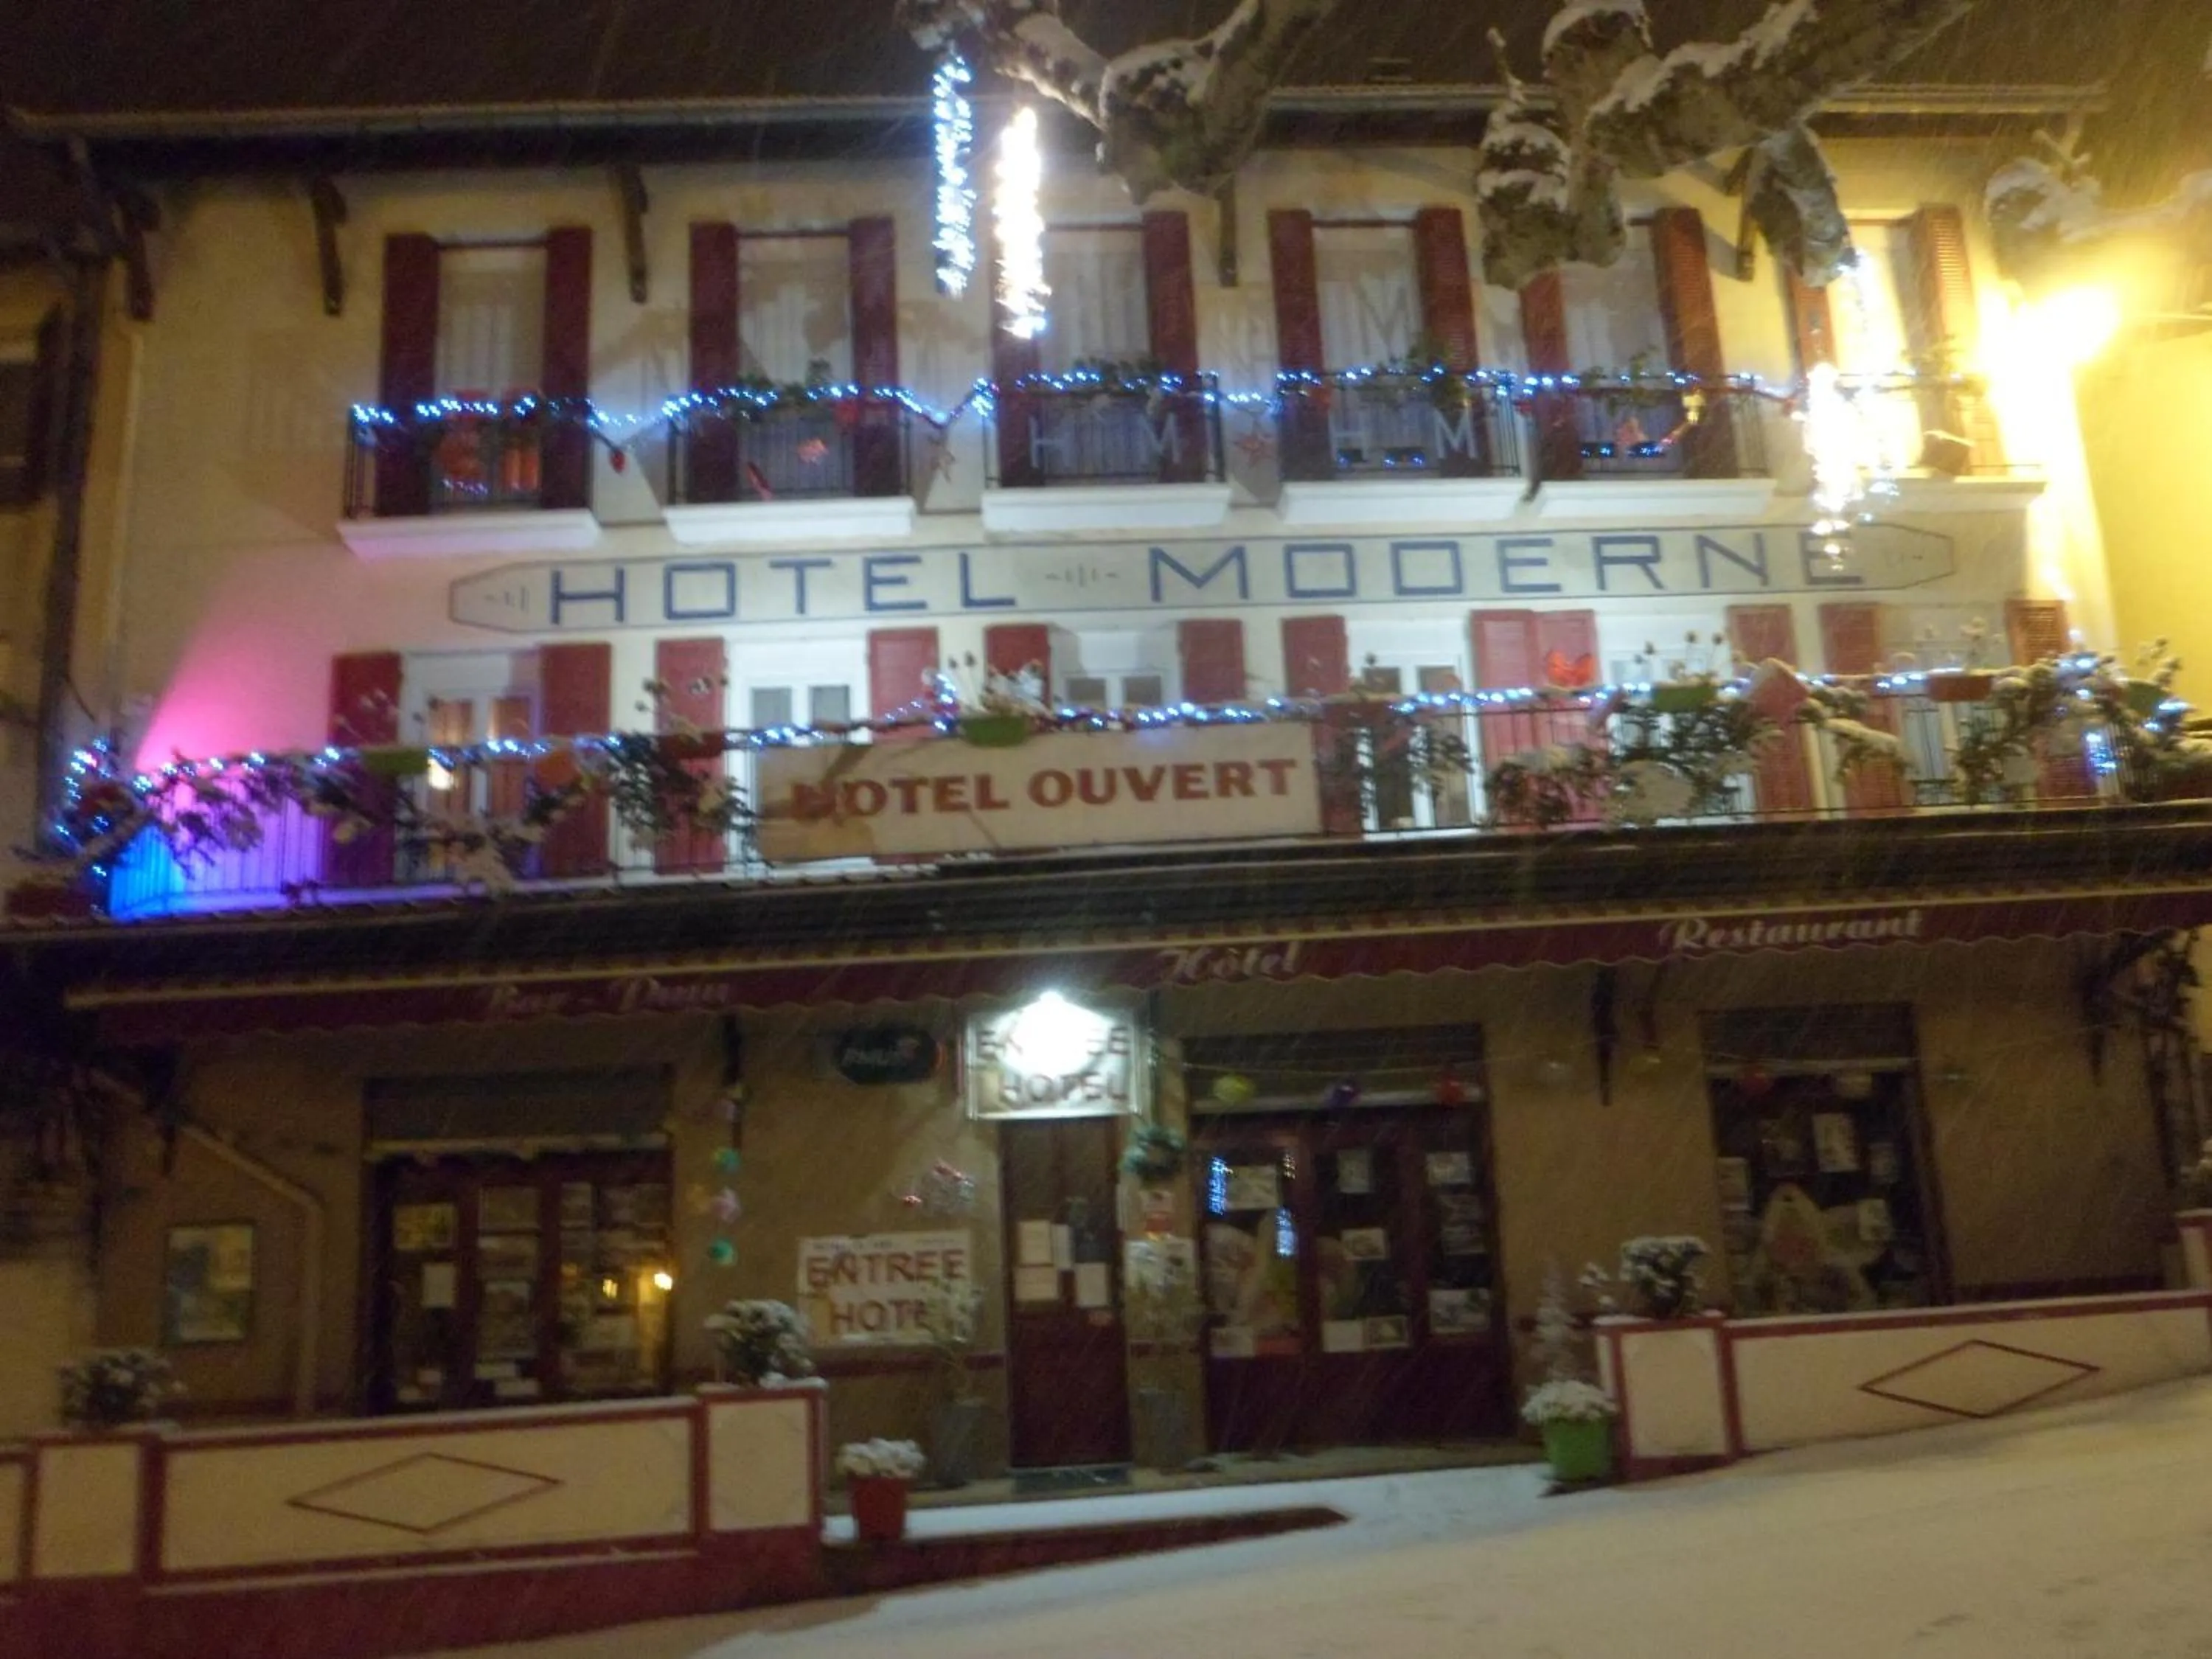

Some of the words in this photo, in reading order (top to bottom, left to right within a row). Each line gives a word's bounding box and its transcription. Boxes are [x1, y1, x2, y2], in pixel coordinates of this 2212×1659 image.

[549, 552, 1016, 625] HOTEL
[1148, 529, 1865, 602] MODERNE
[789, 773, 1010, 821] HOTEL
[1027, 758, 1297, 809] OUVERT
[1659, 908, 1922, 950] Restaurant
[807, 1248, 966, 1287] ENTREE
[830, 1298, 953, 1335] HOTE
